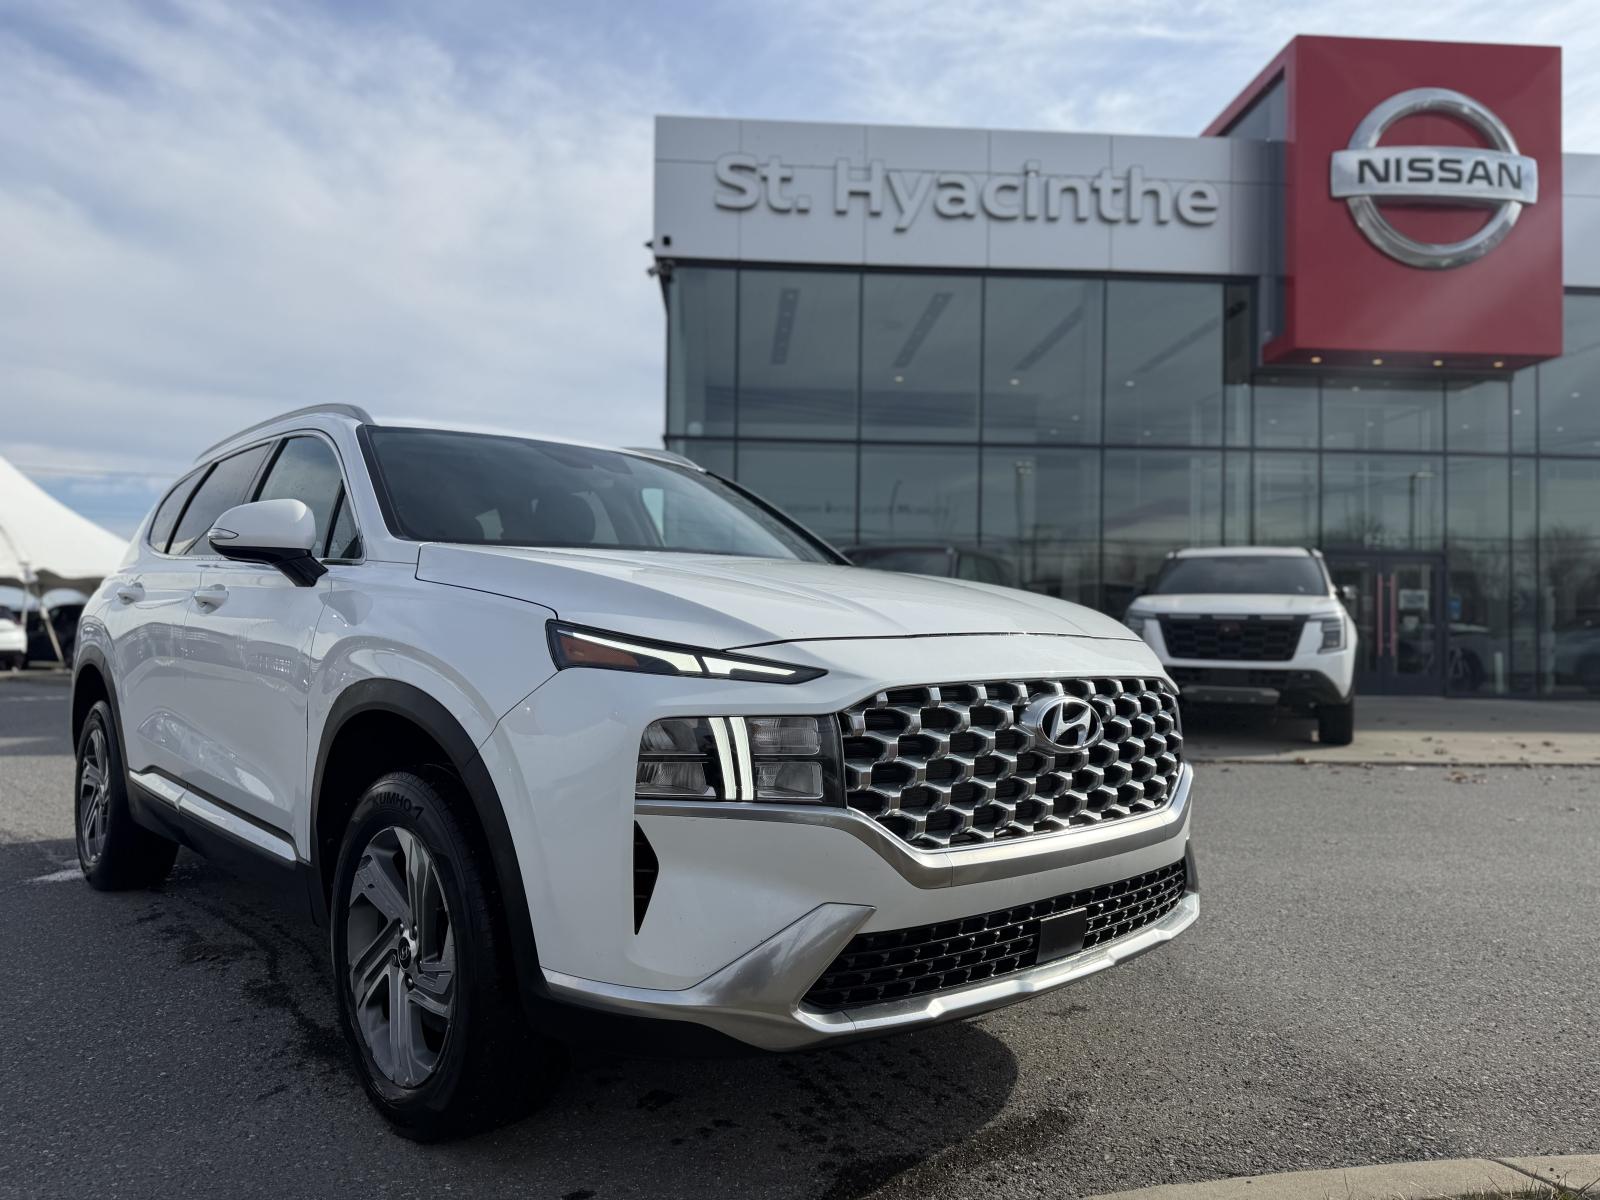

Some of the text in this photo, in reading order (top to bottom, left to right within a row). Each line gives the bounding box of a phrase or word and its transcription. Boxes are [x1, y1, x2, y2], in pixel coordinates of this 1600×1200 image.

[713, 152, 1220, 233] St. Hyacinthe
[1357, 157, 1523, 190] NISSAN
